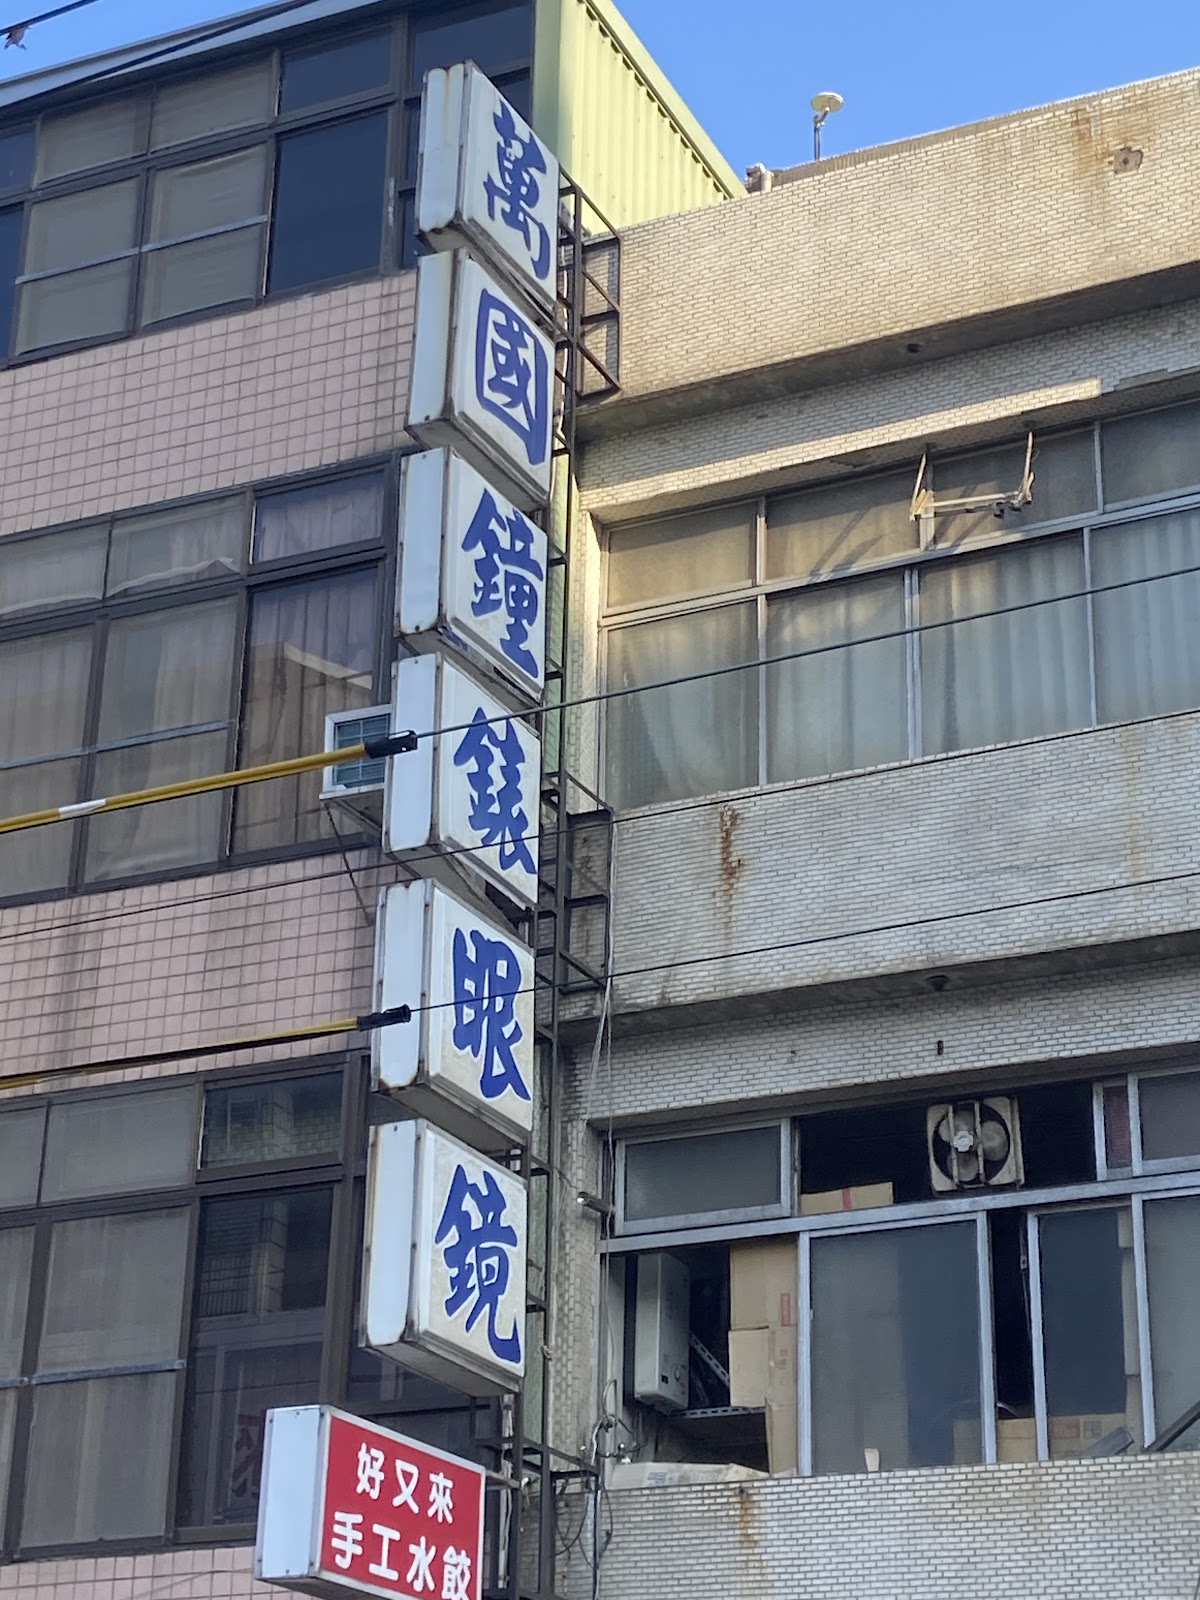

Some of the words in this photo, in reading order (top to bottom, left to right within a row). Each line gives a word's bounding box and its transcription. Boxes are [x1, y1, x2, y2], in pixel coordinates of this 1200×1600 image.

[435, 100, 550, 1364] 萬國鐘錶眼鏡
[356, 1442, 454, 1525] 好又來
[331, 1511, 472, 1600] 手工水餃
